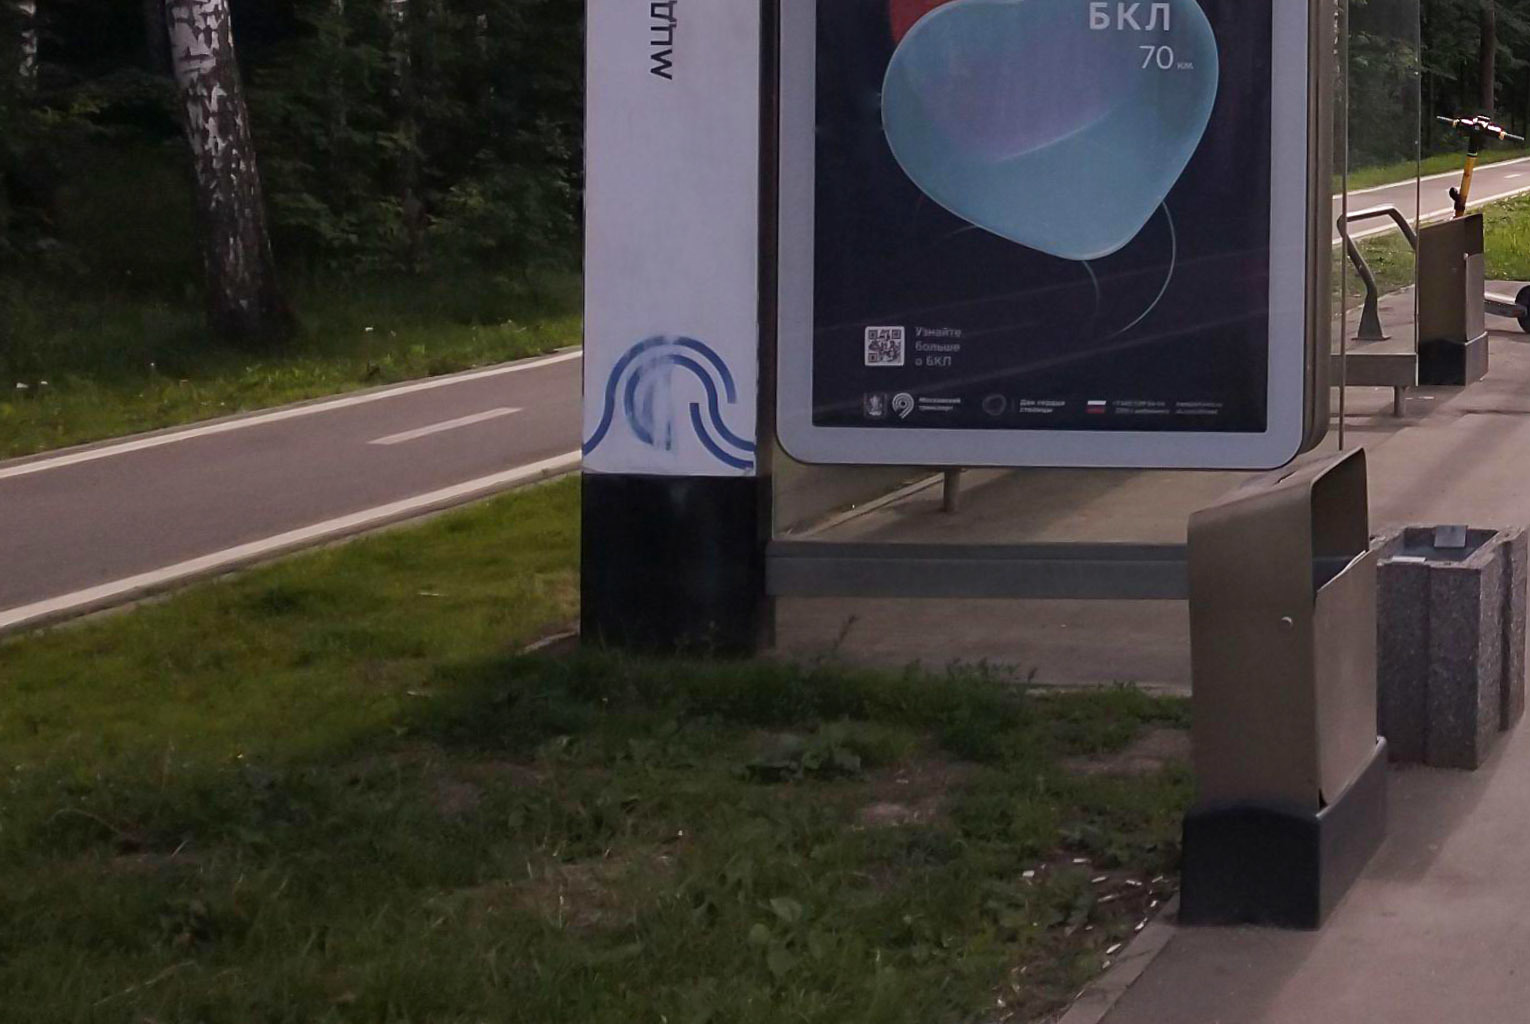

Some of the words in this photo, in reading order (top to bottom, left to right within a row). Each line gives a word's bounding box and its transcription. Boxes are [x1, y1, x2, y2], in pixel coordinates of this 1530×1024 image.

[1089, 2, 1171, 31] БКЛ
[650, 0, 677, 81] МЦД
[1139, 45, 1174, 70] 70
[914, 327, 962, 338] Узнайте
[914, 340, 961, 352] больше
[914, 358, 923, 366] о
[926, 355, 952, 367] БКЛ
